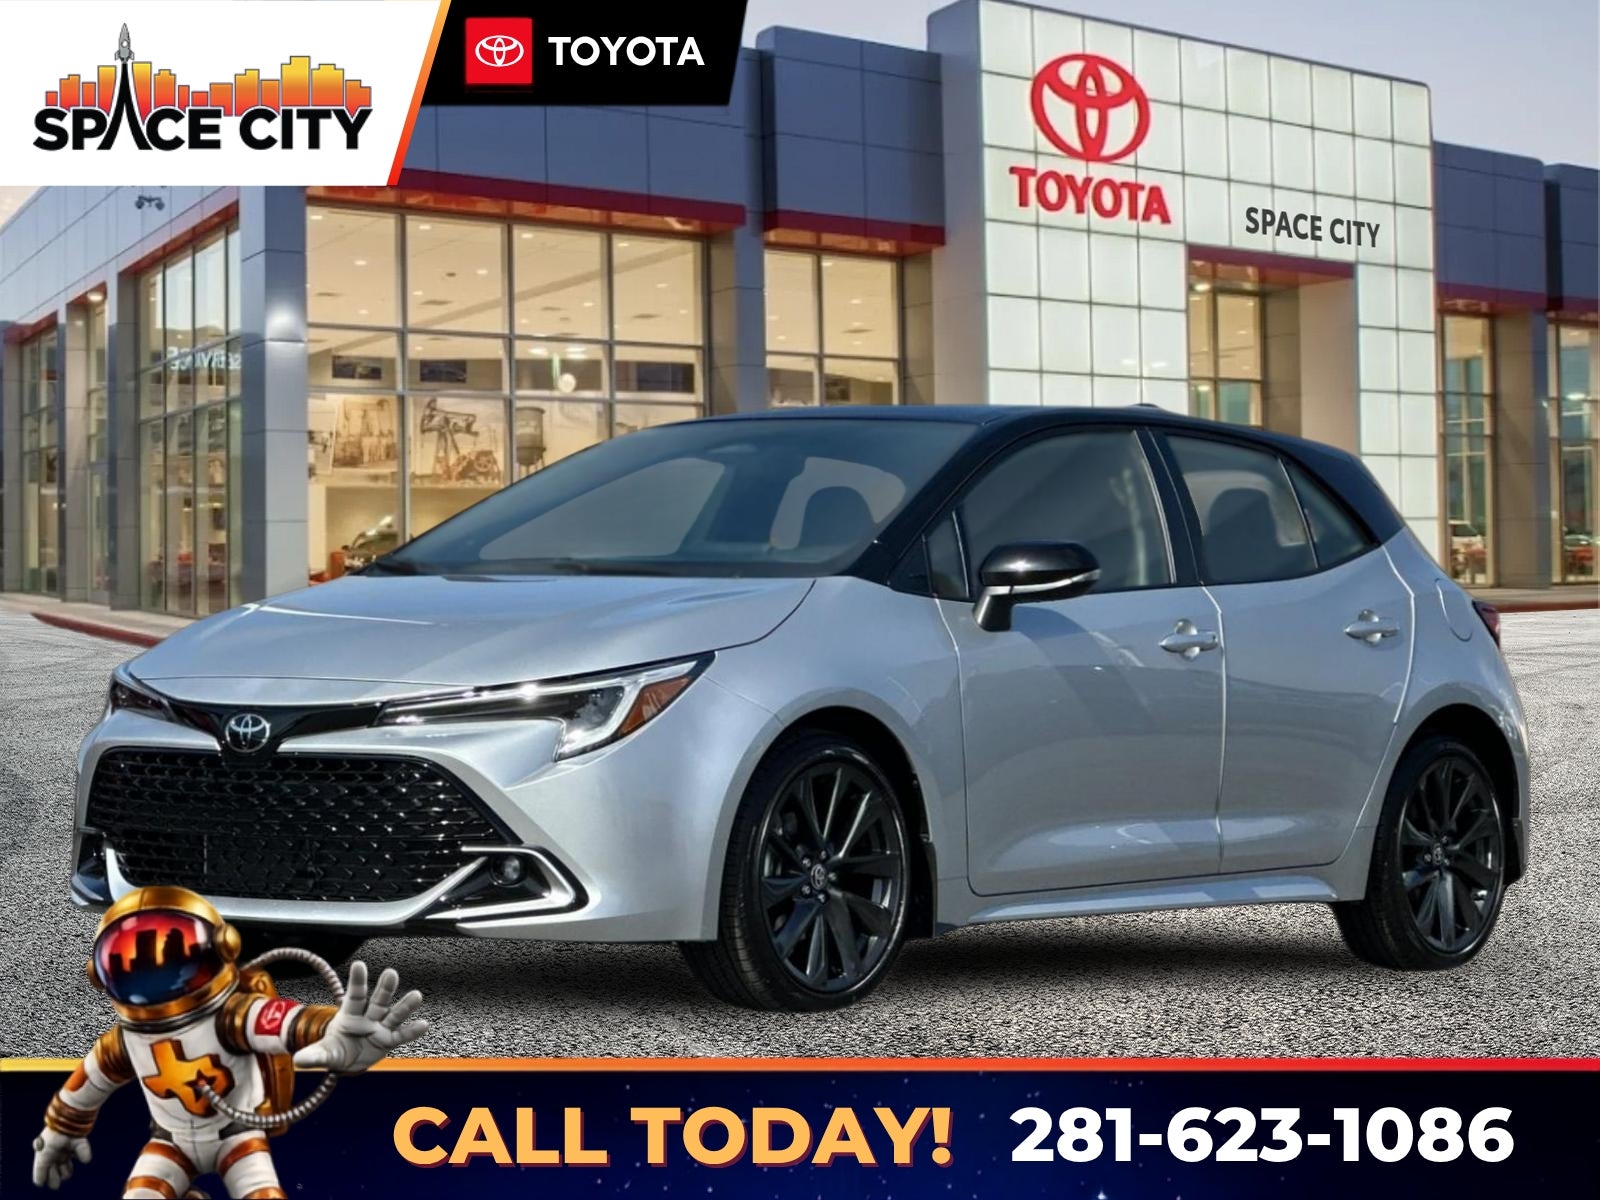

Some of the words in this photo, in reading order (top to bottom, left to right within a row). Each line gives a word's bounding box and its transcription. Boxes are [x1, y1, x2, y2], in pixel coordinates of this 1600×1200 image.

[1009, 166, 1171, 224] TOYOTA
[1245, 207, 1323, 242] SPACE
[1330, 218, 1381, 248] CITY
